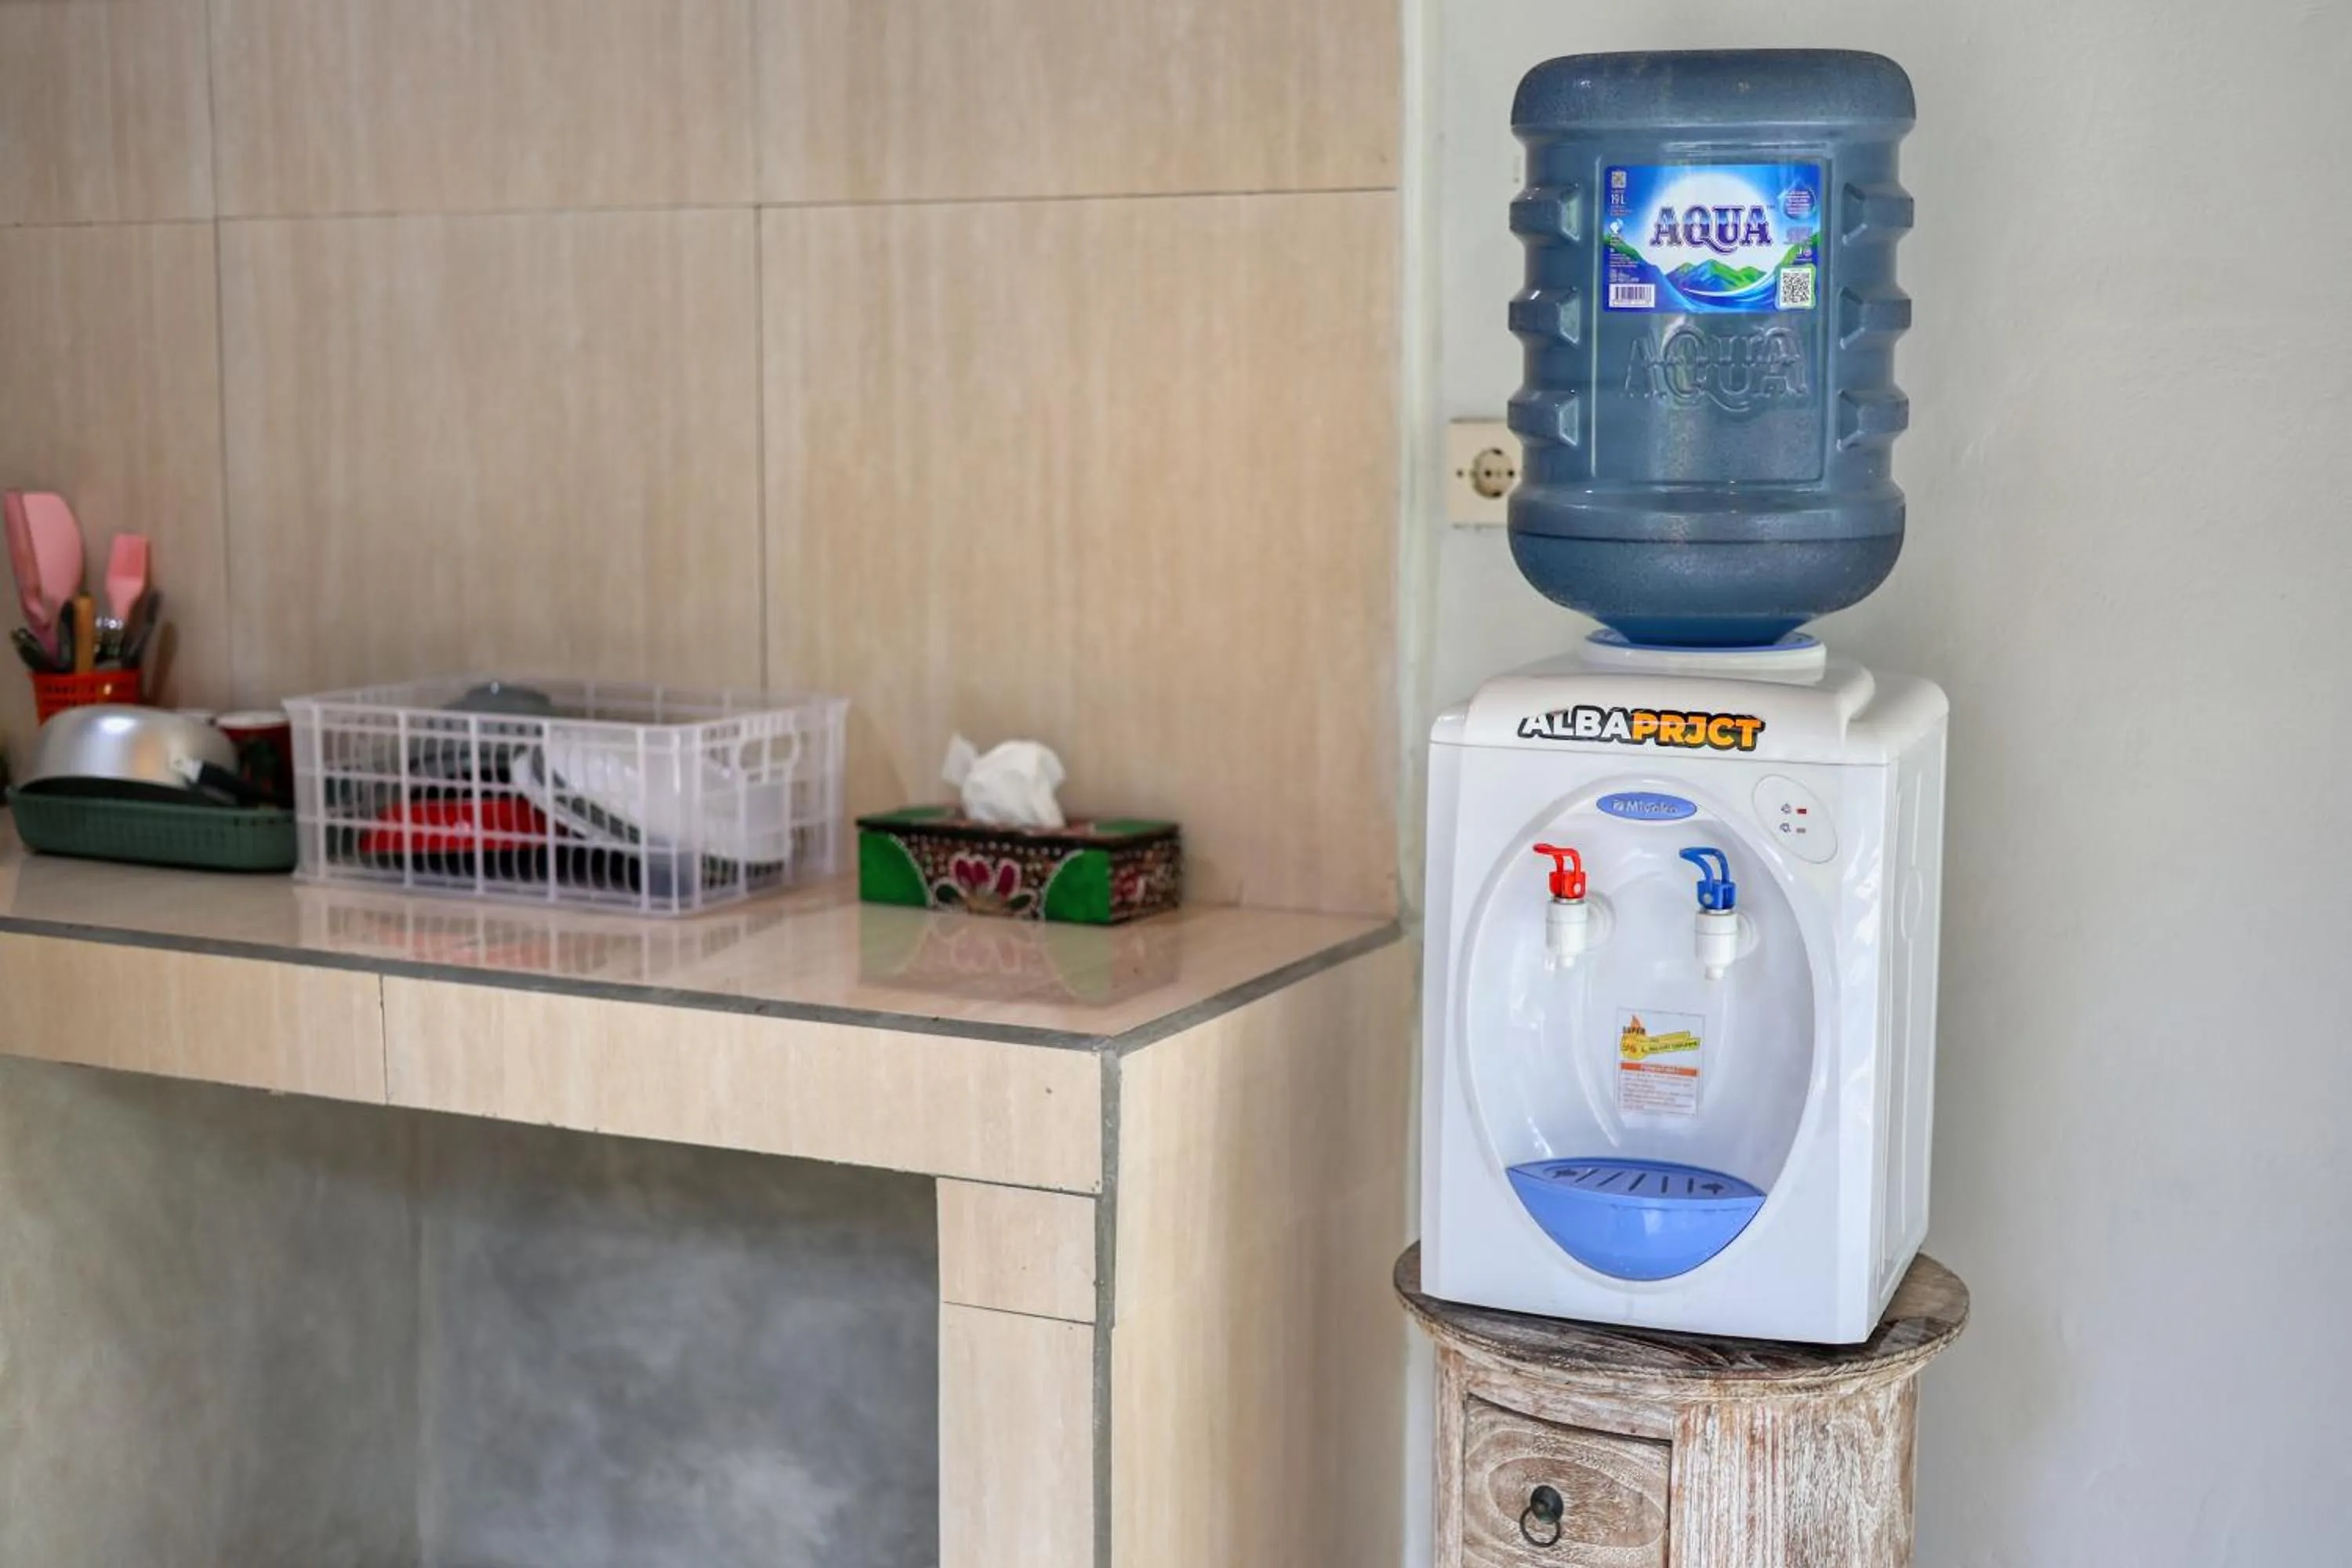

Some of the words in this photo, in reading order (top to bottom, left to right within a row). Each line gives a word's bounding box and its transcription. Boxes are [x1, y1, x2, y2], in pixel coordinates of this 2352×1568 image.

[1650, 205, 1772, 255] AQUA
[1621, 325, 1809, 416] AQUA
[1519, 706, 1765, 750] ALBAPRJCT
